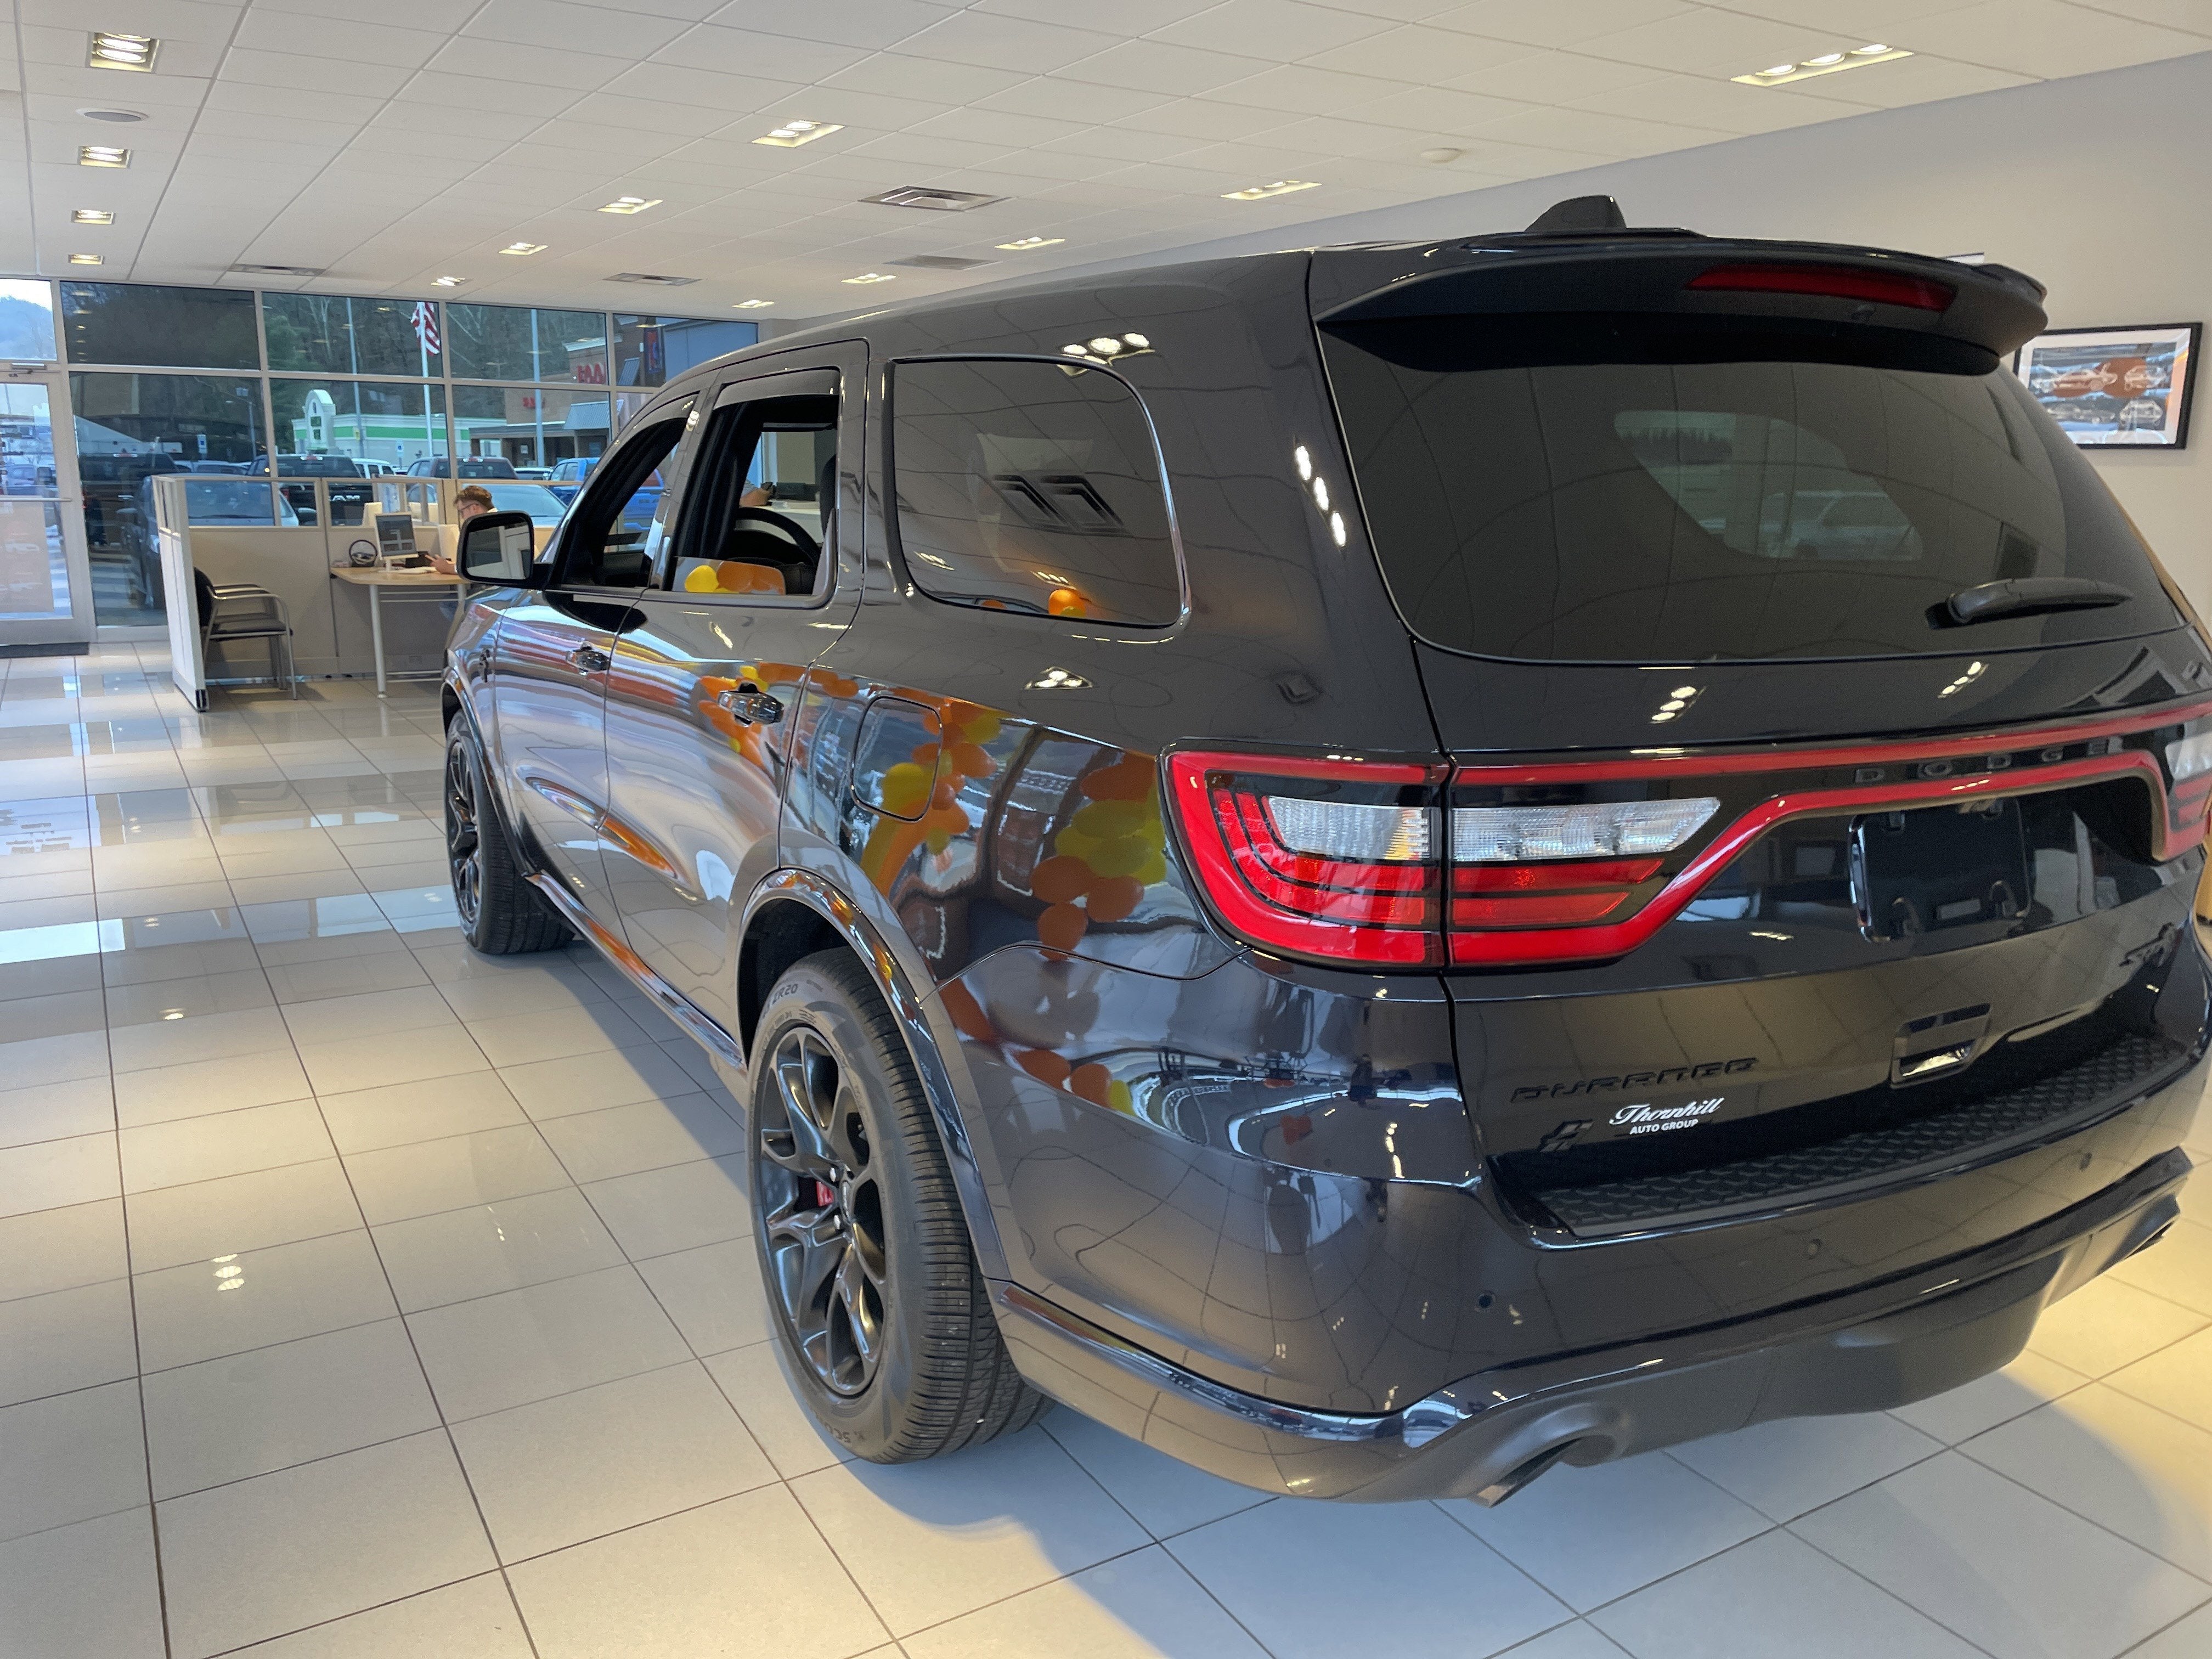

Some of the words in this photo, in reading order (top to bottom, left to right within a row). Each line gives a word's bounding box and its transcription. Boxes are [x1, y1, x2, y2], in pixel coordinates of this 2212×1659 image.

[1855, 739, 2107, 783] DODGE
[1511, 1058, 1758, 1103] DURANGO
[1609, 1097, 1724, 1125] Thornhill
[1629, 1124, 1660, 1135] AUTO
[1661, 1119, 1699, 1131] GROUP
